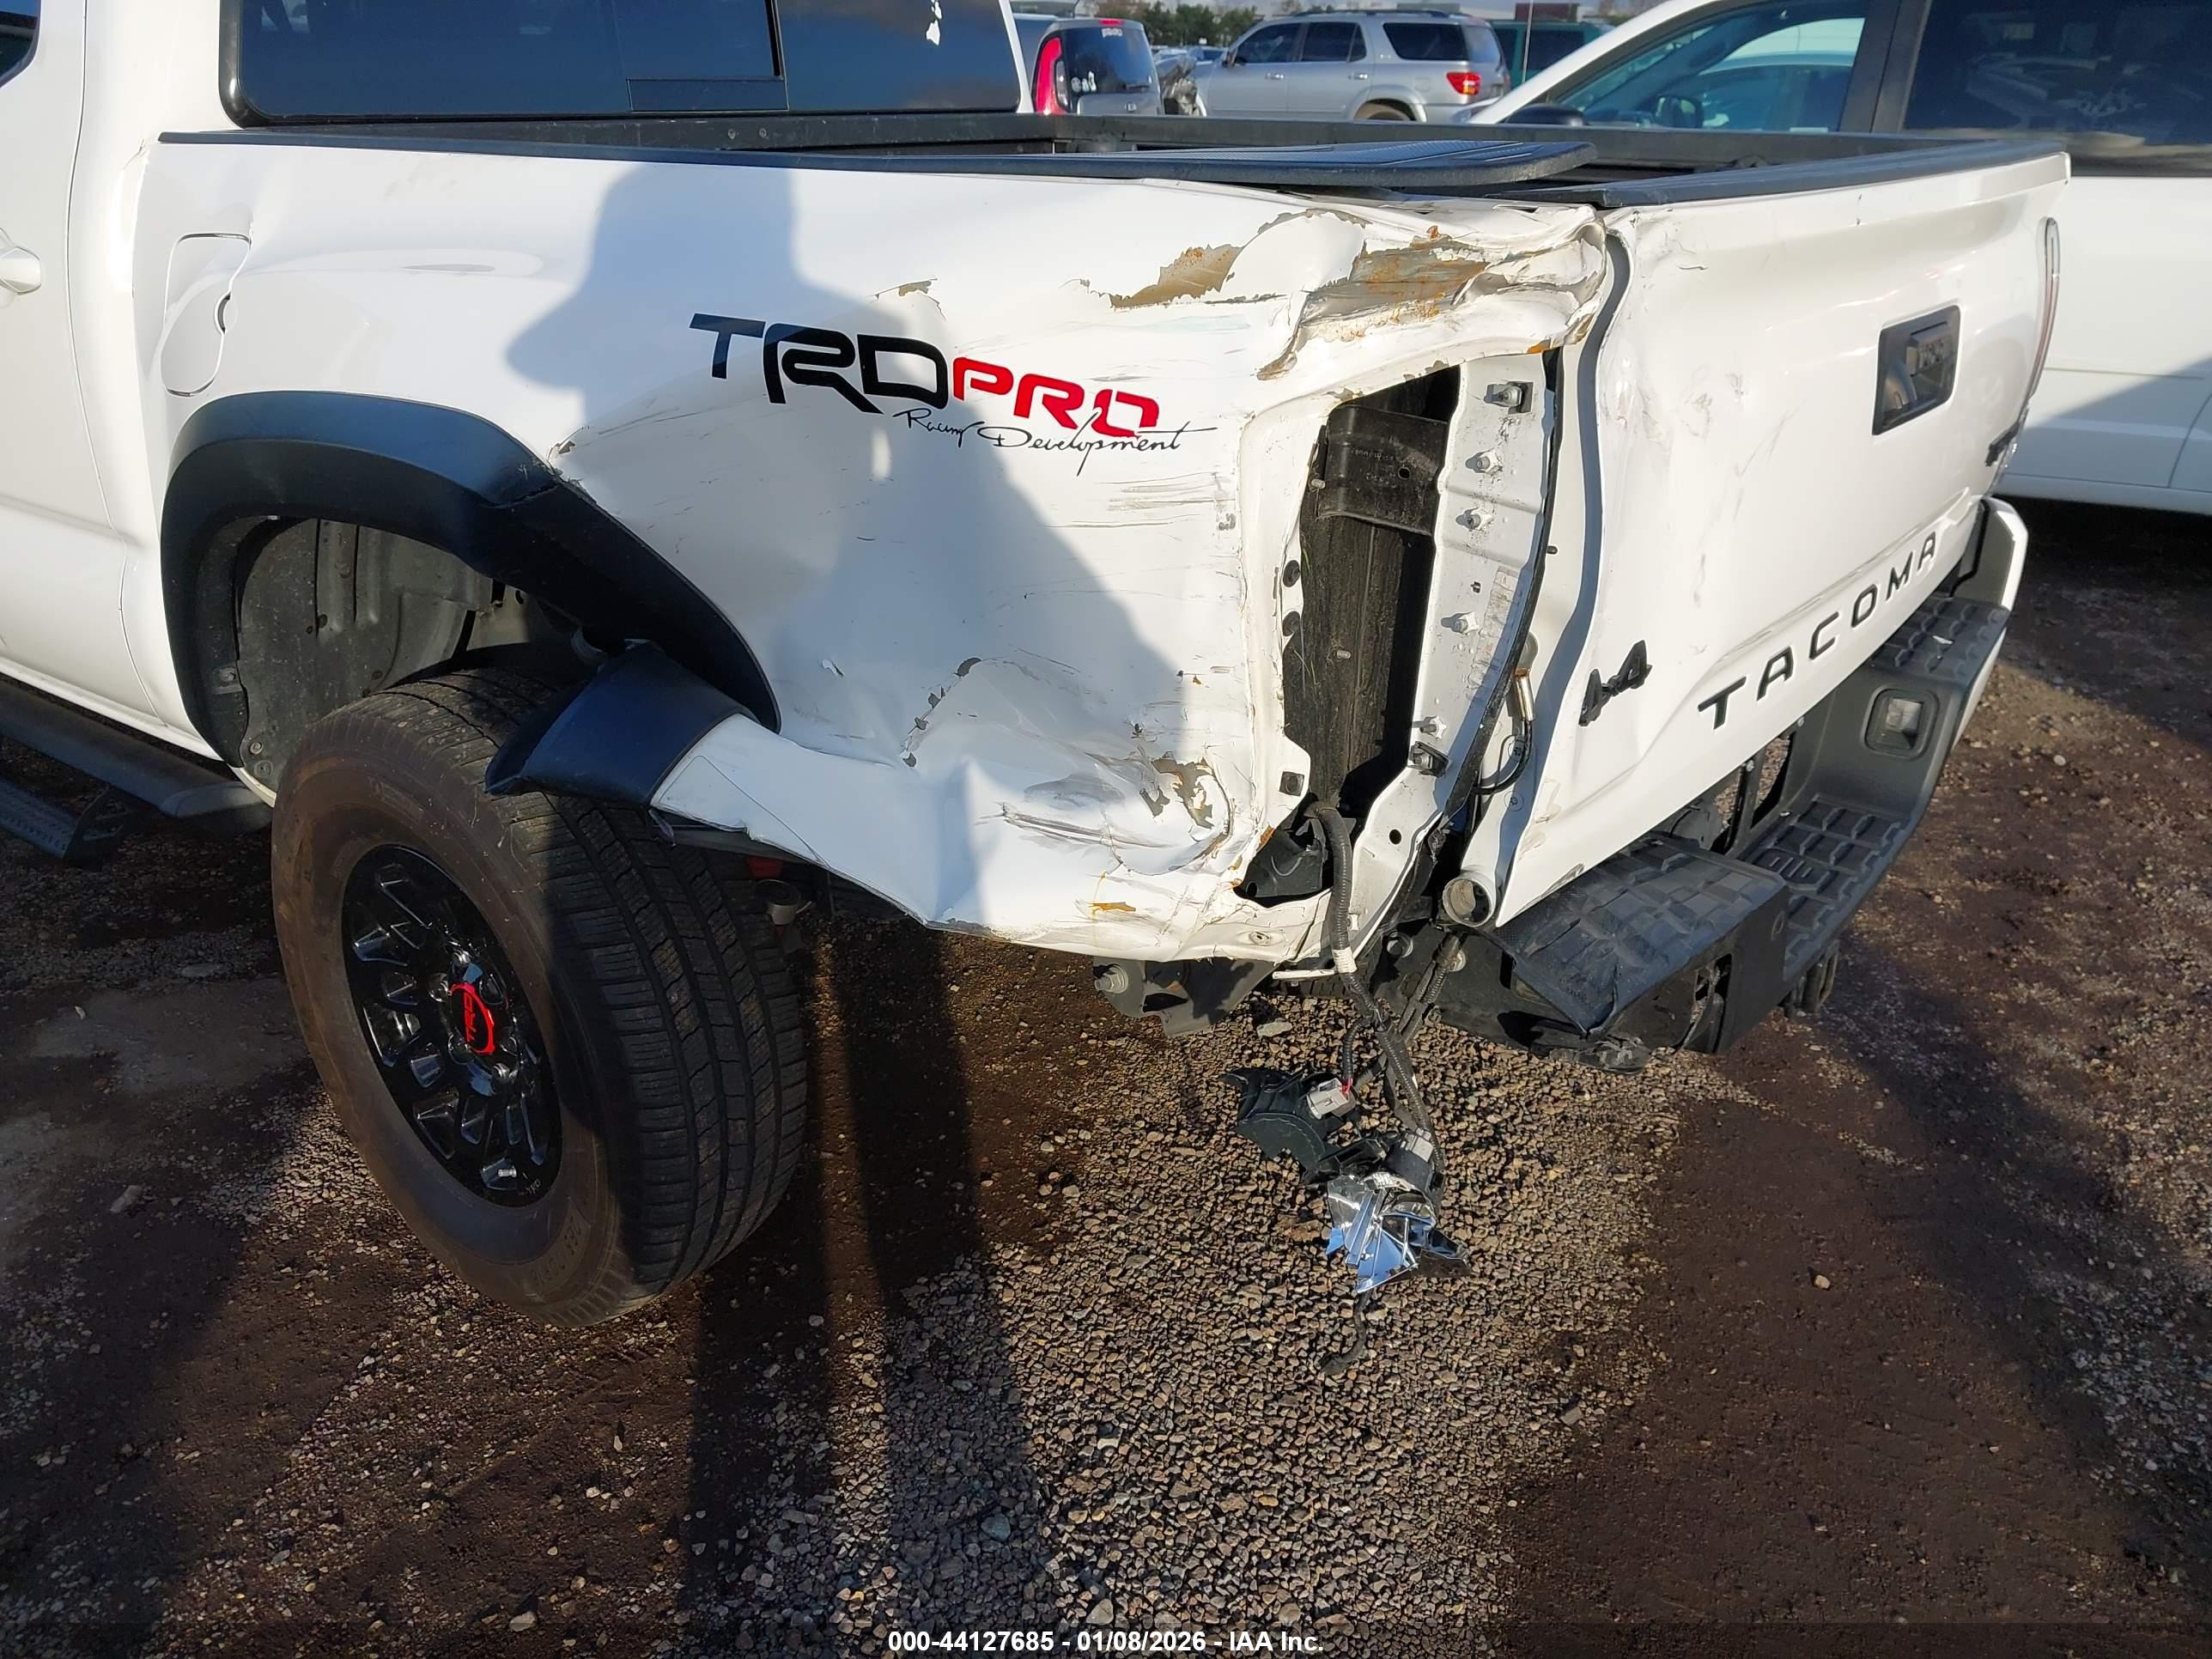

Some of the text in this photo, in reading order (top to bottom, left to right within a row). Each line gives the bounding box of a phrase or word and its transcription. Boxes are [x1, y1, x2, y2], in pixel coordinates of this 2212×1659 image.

[689, 312, 1160, 438] TRD PRO
[892, 407, 1218, 477] Racing Development
[1698, 531, 1937, 730] TACOMA
[464, 992, 477, 1042] TRD
